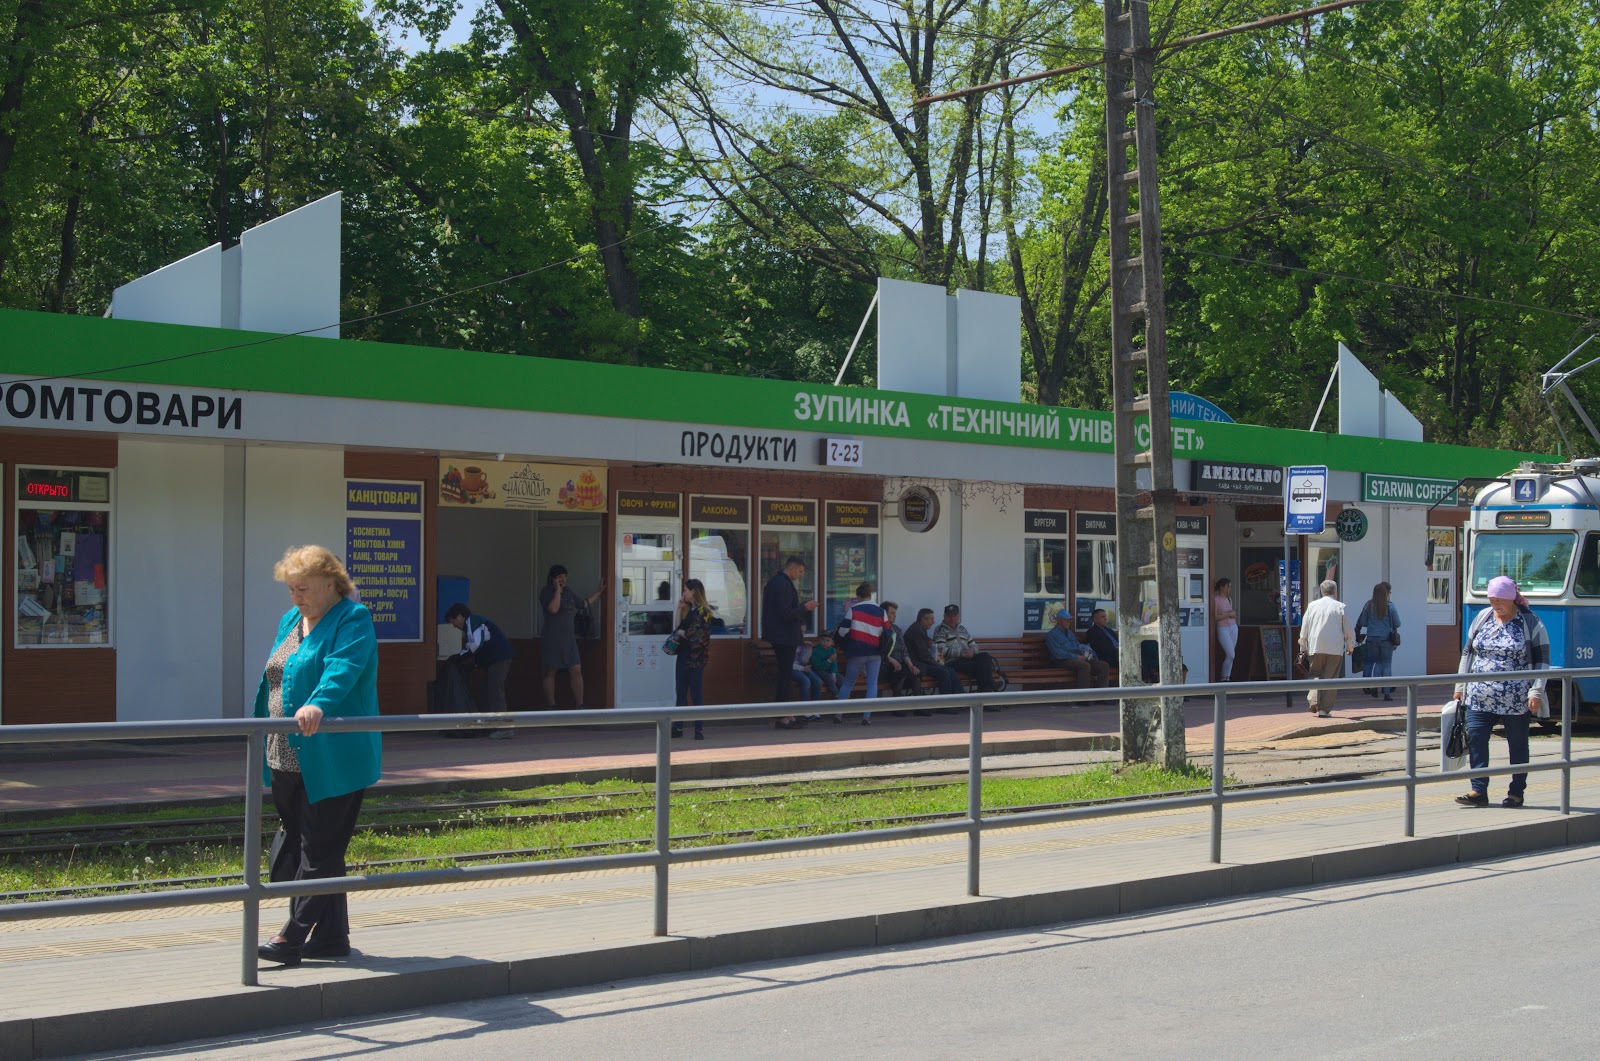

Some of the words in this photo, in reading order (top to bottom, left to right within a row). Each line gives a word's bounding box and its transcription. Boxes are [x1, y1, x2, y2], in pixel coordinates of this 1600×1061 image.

[1170, 398, 1195, 416] НИЙ
[794, 392, 911, 428] ЗУПИНКА
[927, 404, 1060, 439] «ТЕХНІЧНИЙ
[1068, 416, 1205, 451] УНІВСЕТ»
[681, 431, 796, 464] ПРОДУКТИ
[831, 442, 859, 463] 7-23
[1201, 465, 1281, 484] AMERICANO
[27, 482, 69, 498] ОТКРЫТО
[502, 480, 551, 497] НАСОЛОДА
[1371, 479, 1414, 498] STARVIN
[1415, 483, 1454, 501] COFFEE
[1519, 480, 1531, 498] 4
[348, 488, 418, 506] КАНЦТОВАРИ
[620, 498, 644, 509] ОВОЧІ
[650, 500, 677, 510] ФРУКТИ
[770, 503, 804, 513] ПРОДУКТИ
[701, 505, 738, 516] АЛКОГОЛЬ
[835, 505, 869, 515] ТЮТЮНОВІ
[766, 514, 808, 524] ХАРЧУВАННЯ
[840, 516, 864, 525] ВИРОБИ
[1033, 517, 1056, 527] БУРГЕРИ
[1085, 520, 1107, 529] ВИПІЧКА
[1176, 520, 1188, 529] КАВА
[1190, 519, 1200, 530] ЧАЙ
[353, 527, 391, 537] КОСМЕТИКА
[353, 539, 386, 549] ПОБУТОВА
[386, 540, 405, 549] ХІМІЯ
[352, 551, 372, 562] КАНЦ.
[373, 552, 398, 561] ТОВАРИ
[352, 563, 384, 573] РУШНИКИ
[387, 564, 412, 574] ХАЛАТИ
[389, 577, 417, 586] БІЛИЗНА
[386, 589, 409, 600] ПОСУД
[376, 601, 394, 611] ДРУК
[372, 613, 397, 623] ВЗУТТЯ
[1576, 646, 1594, 660] 319
